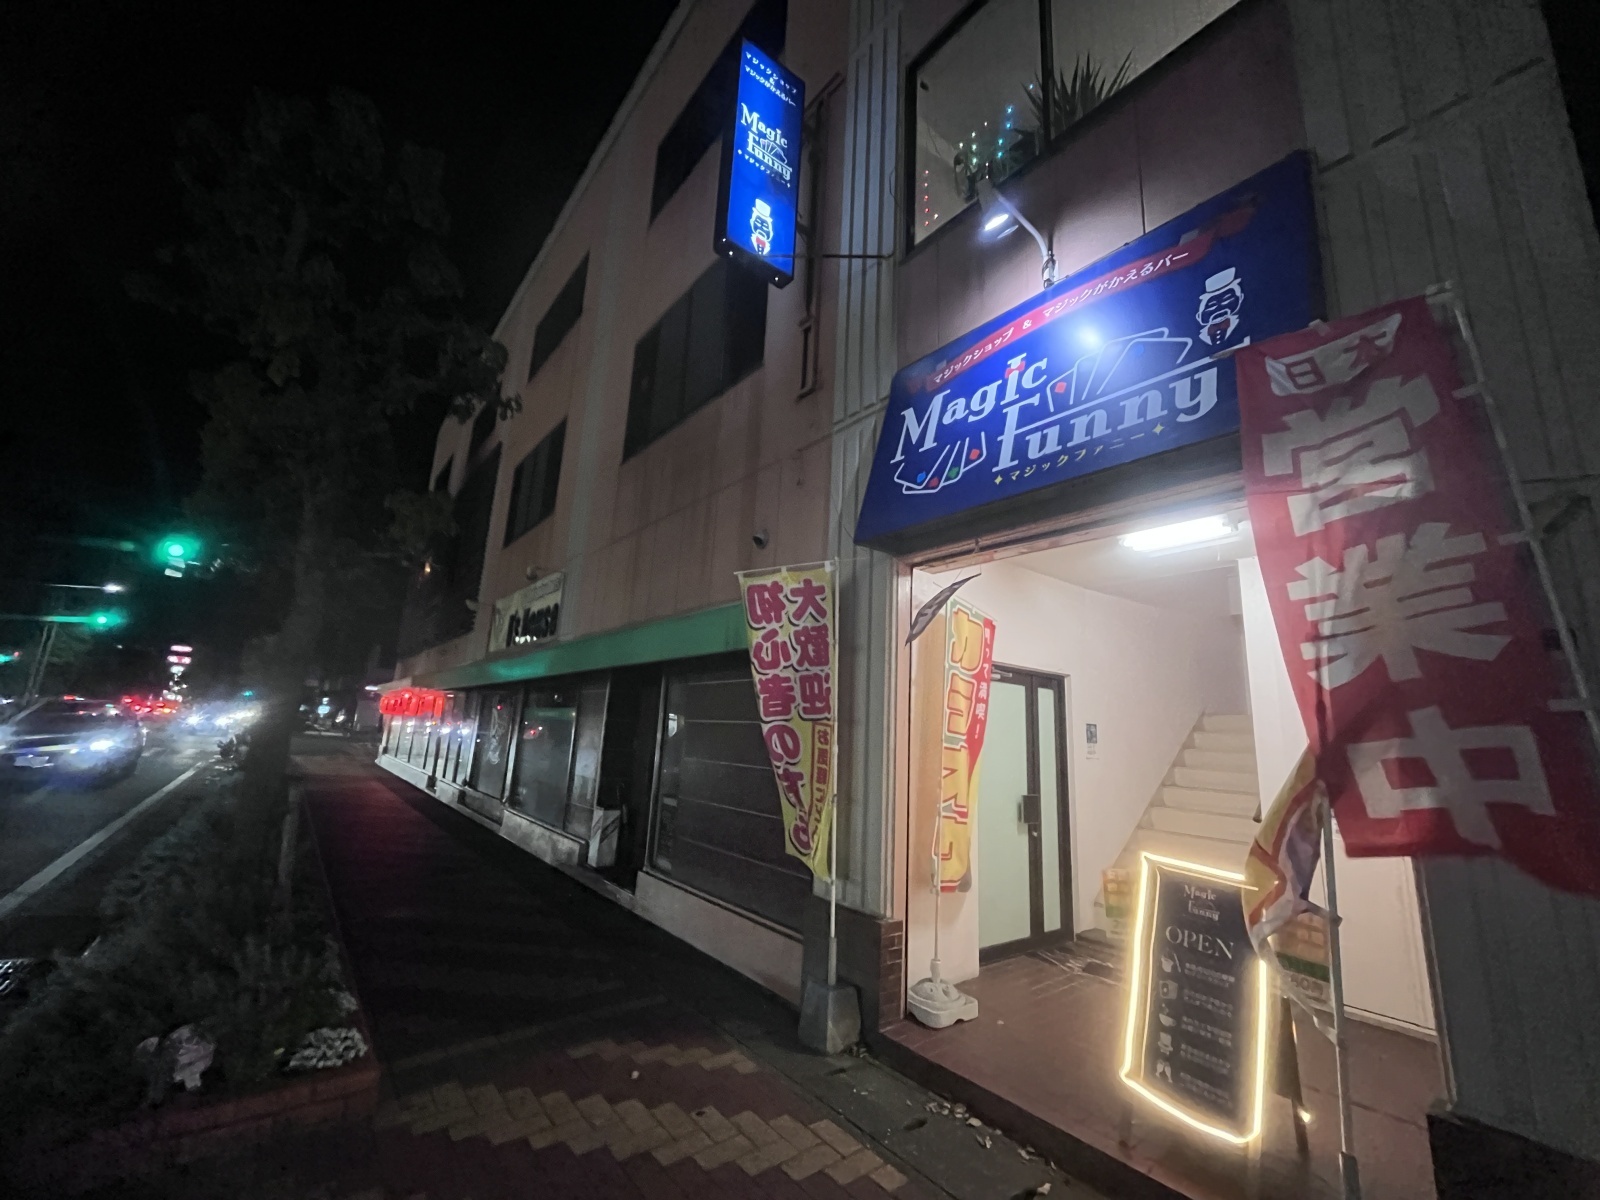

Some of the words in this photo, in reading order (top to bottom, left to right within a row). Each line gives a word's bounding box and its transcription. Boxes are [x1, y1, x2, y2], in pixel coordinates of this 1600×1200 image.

[740, 102, 788, 149] Magic
[746, 130, 793, 181] Funny
[933, 326, 1016, 384] マジックショップ
[1022, 318, 1033, 331] &
[1043, 251, 1190, 318] マジックがかえるバー
[891, 352, 1049, 464] Magic
[992, 360, 1220, 473] Funny
[1009, 431, 1146, 481] マジックファニー
[1183, 884, 1217, 900] Magic
[1165, 925, 1234, 960] OPEN
